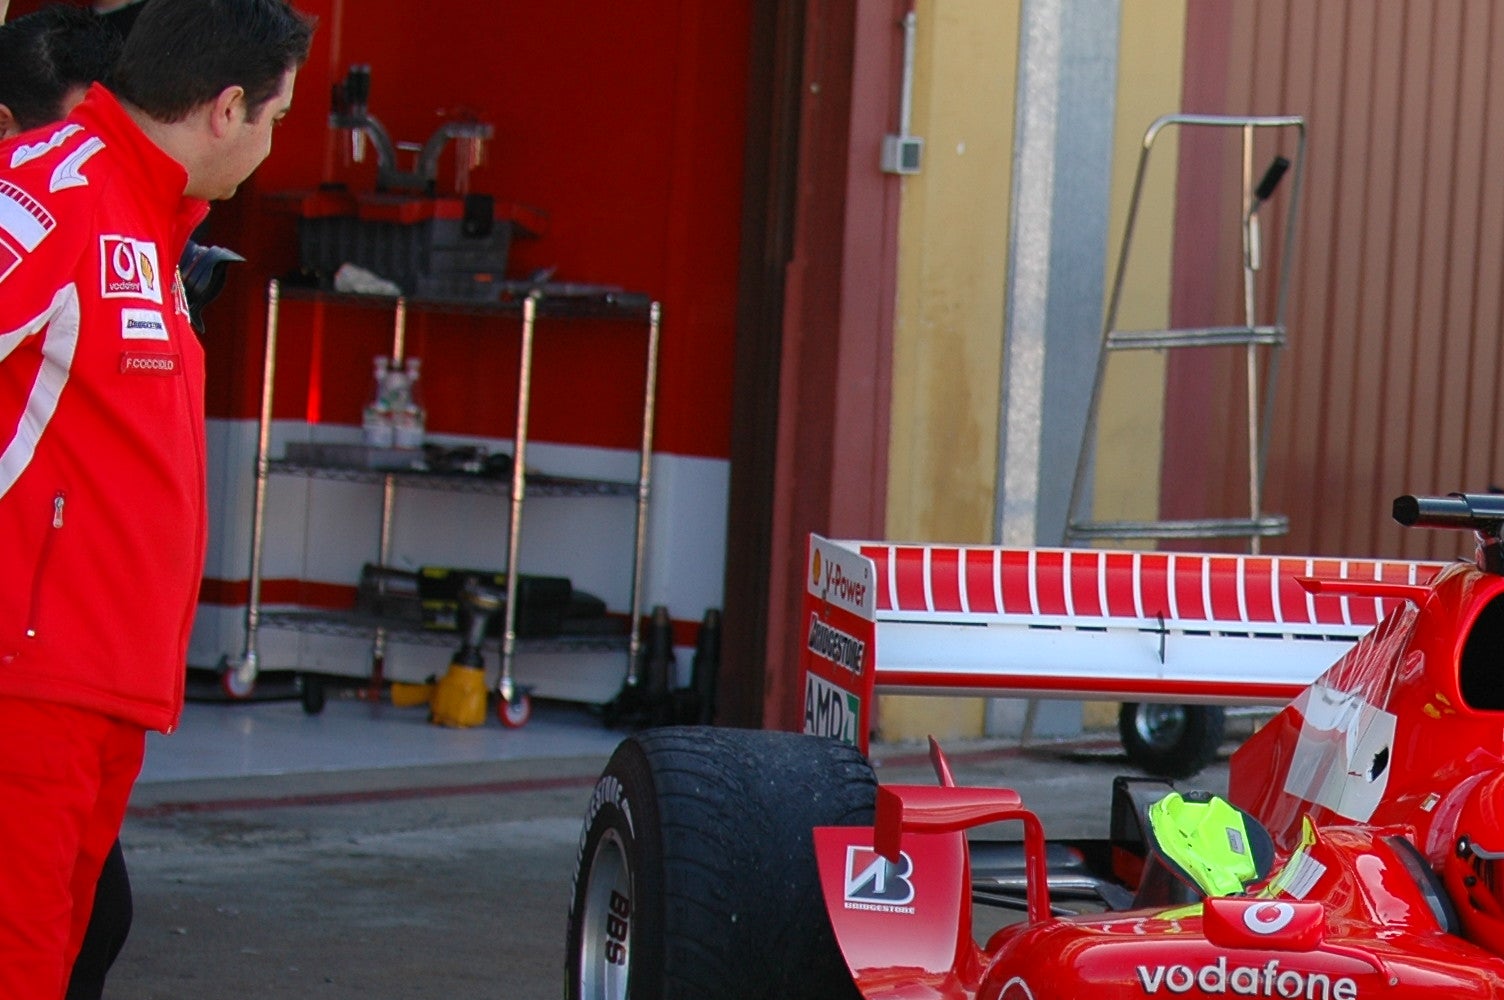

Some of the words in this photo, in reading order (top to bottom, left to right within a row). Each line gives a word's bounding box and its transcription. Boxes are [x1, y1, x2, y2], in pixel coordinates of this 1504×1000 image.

[825, 559, 866, 607] V-Power
[810, 616, 864, 674] BRIDGESTONE
[805, 678, 843, 739] AMD
[844, 902, 915, 914] BRIDGESTONE
